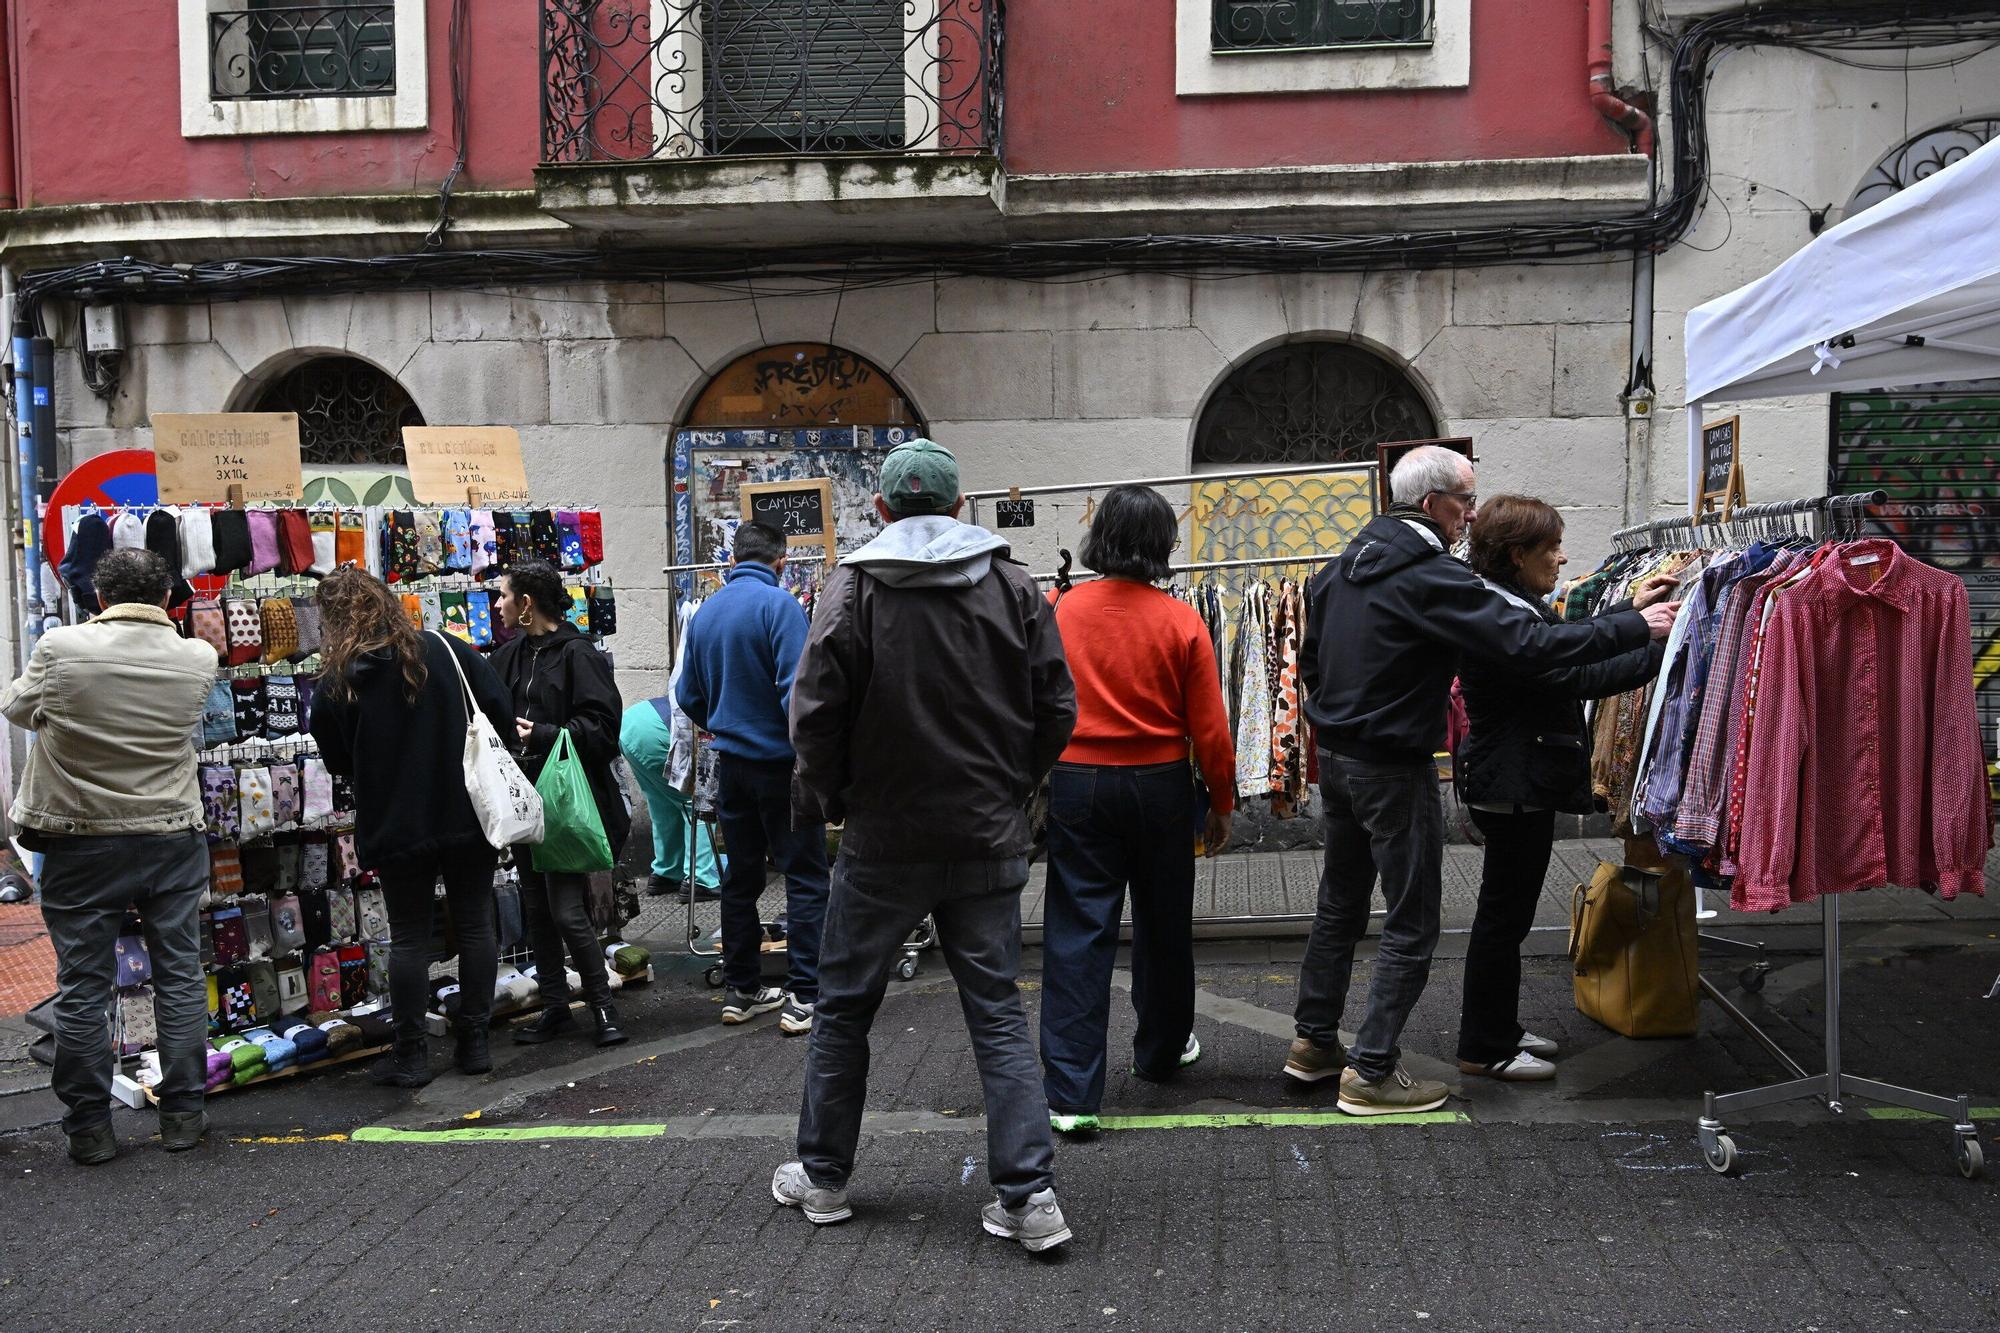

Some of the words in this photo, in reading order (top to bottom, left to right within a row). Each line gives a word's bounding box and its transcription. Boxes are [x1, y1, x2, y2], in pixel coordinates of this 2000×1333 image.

[1710, 443, 1732, 460] VINTAGE
[1709, 462, 1731, 480] JAPONES
[756, 495, 819, 511] CAMISAS
[997, 501, 1033, 512] JERSEYS
[783, 511, 806, 527] 29€
[1009, 513, 1031, 527] 29€
